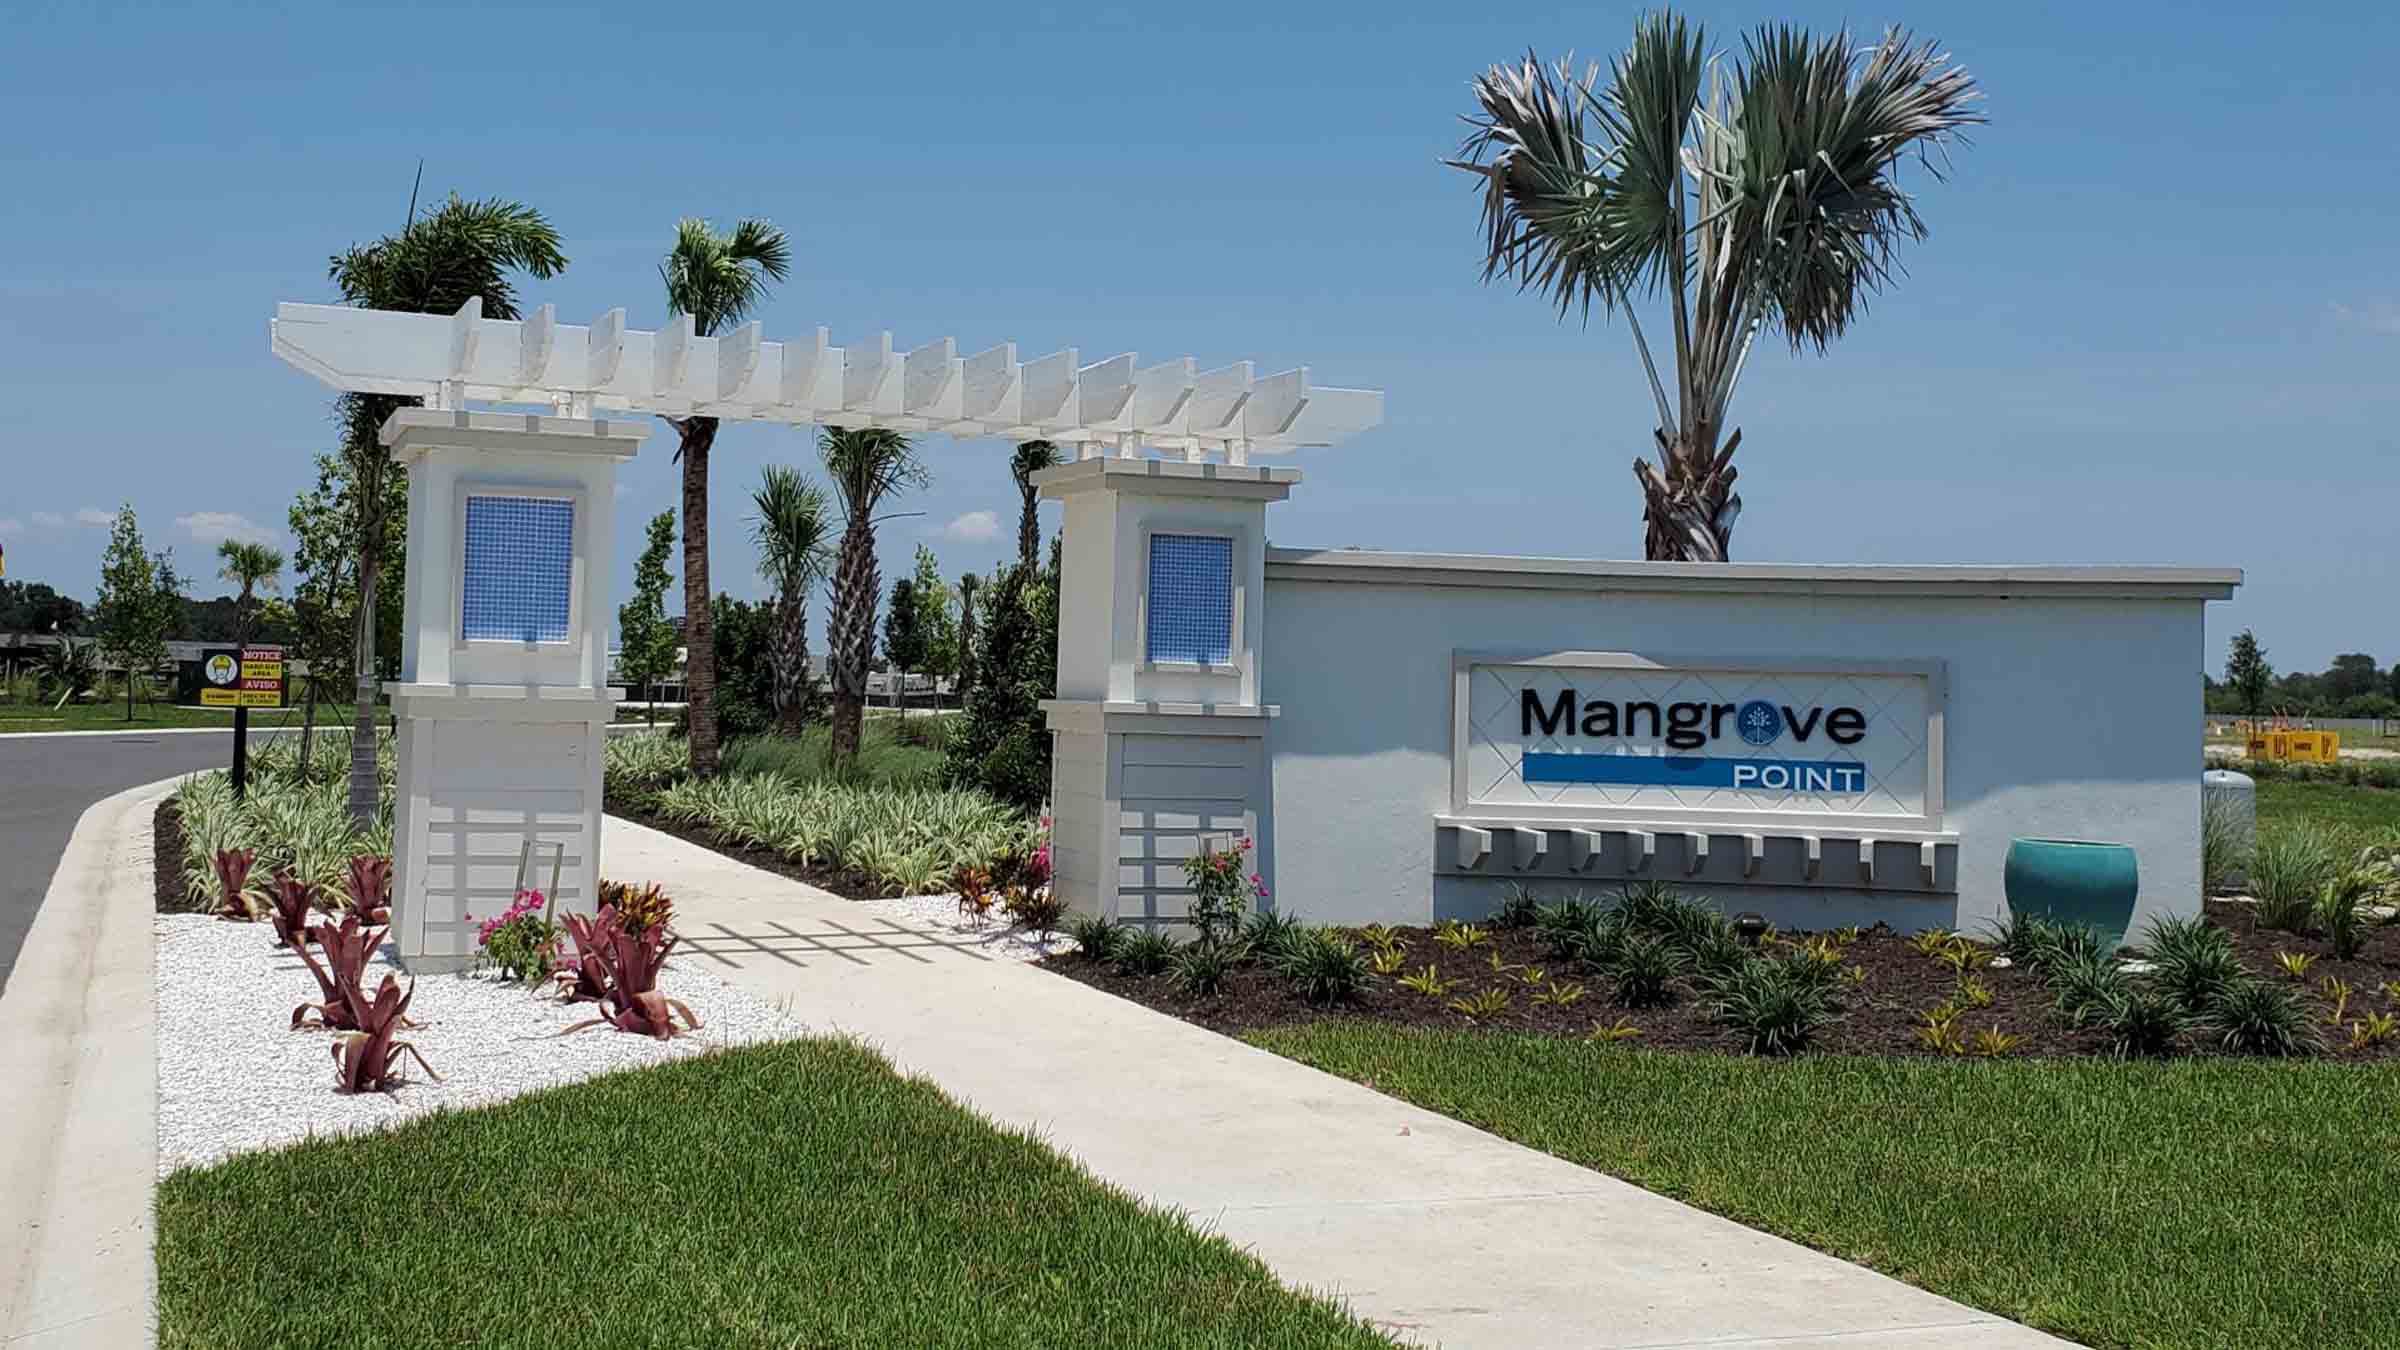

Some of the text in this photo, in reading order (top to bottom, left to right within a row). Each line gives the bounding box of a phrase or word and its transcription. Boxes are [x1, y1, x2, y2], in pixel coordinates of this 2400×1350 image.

[243, 651, 281, 659] NOTICE
[246, 680, 278, 689] AVISO
[1521, 688, 1866, 751] Mangrove
[1733, 765, 1864, 792] POINT
